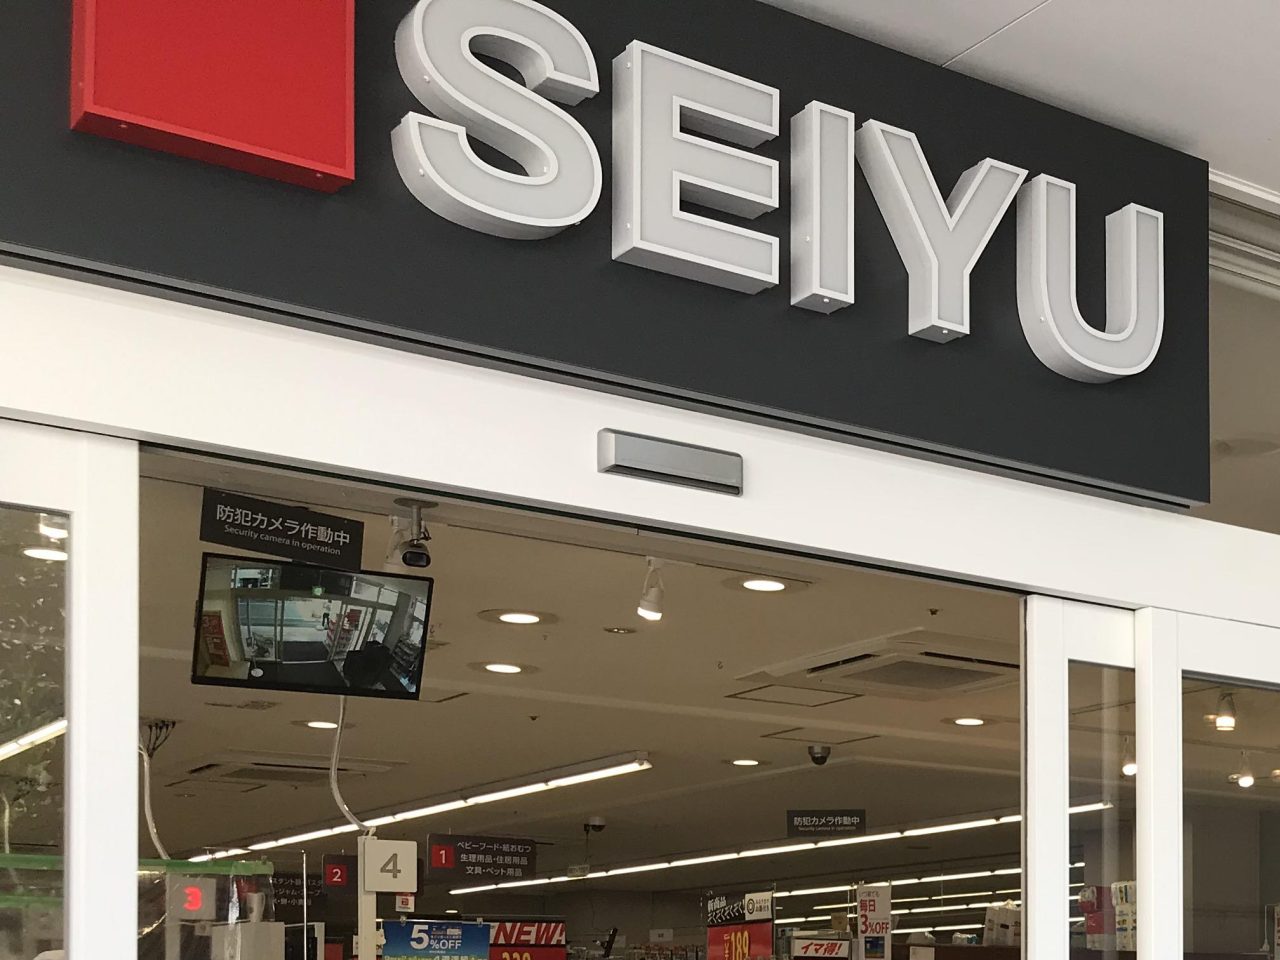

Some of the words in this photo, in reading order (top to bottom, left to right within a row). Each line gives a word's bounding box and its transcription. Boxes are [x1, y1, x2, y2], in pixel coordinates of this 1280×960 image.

[391, 0, 1165, 385] SEIYU
[216, 504, 351, 546] 防犯カメラ作動中
[224, 524, 259, 540] Security
[259, 532, 291, 545] camera
[292, 538, 300, 547] in
[301, 541, 341, 556] operation
[380, 852, 402, 879] 4
[439, 850, 447, 864] 1
[332, 868, 342, 882] 2
[859, 899, 876, 913] 毎日
[860, 914, 890, 934] 3%OFF
